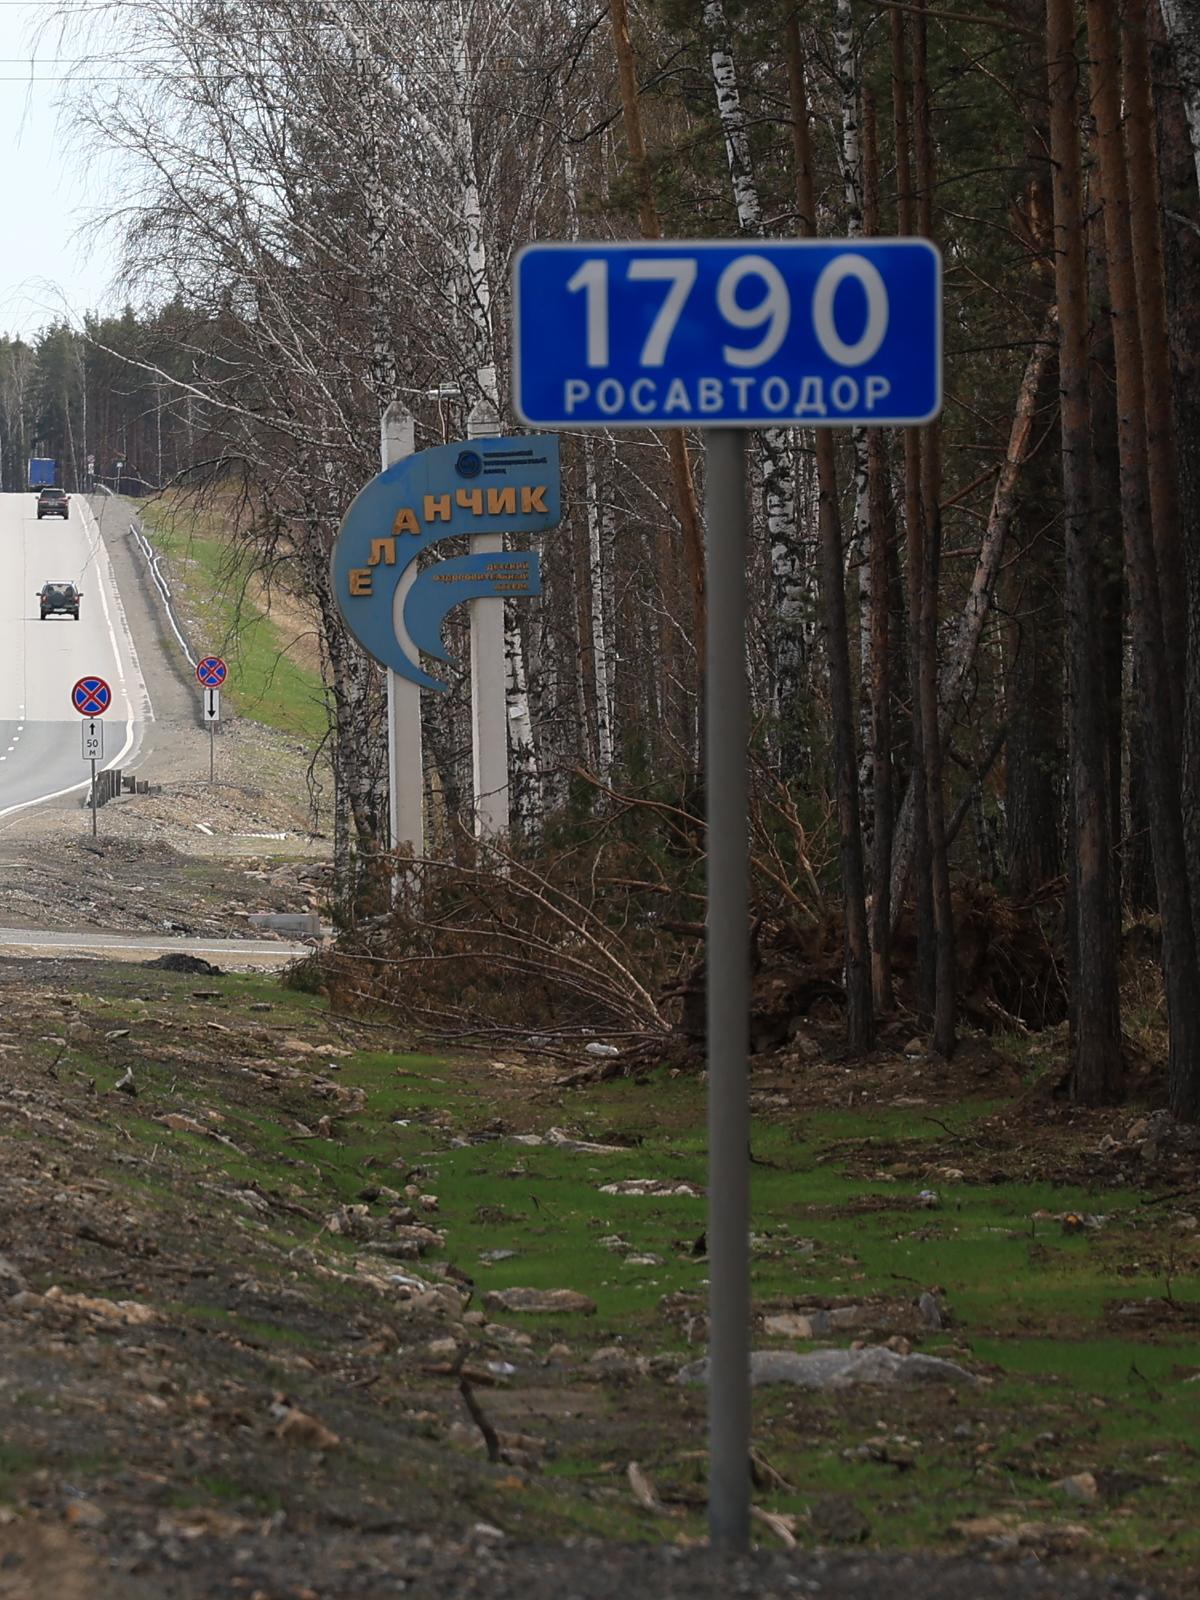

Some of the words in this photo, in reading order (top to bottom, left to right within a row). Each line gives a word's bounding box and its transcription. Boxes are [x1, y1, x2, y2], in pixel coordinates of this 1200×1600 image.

[566, 253, 889, 369] 1790
[564, 375, 892, 416] РОСАВТОДОР
[348, 486, 548, 597] ЕЛАНЧИК
[86, 738, 99, 748] 50
